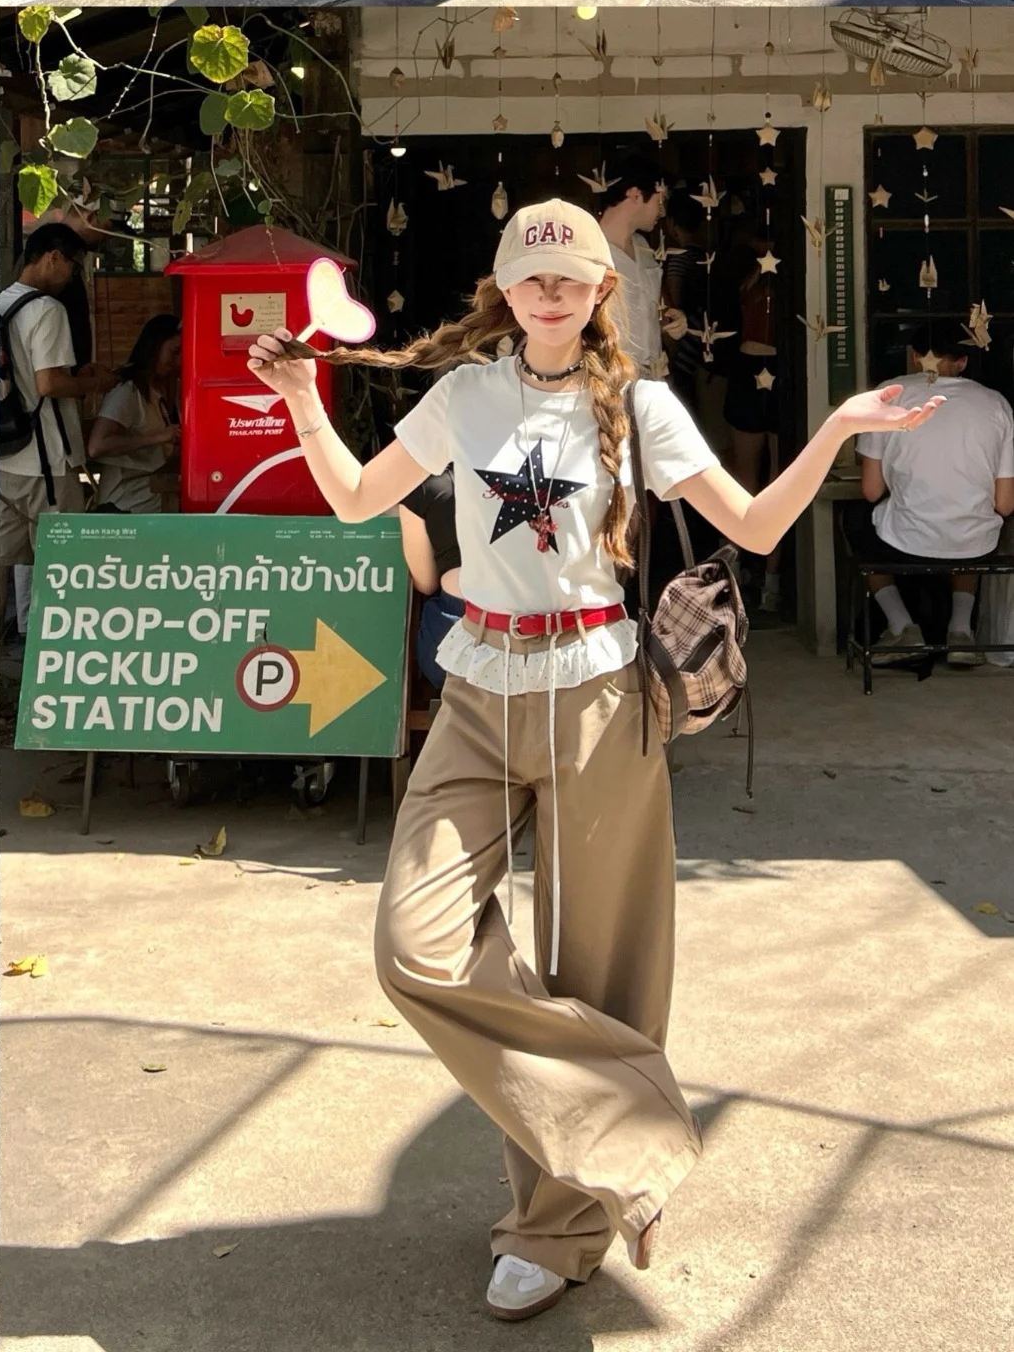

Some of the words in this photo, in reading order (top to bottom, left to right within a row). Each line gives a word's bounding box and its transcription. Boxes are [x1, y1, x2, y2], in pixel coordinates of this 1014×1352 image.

[524, 221, 575, 248] GAP
[229, 429, 263, 437] THAILAND
[264, 428, 284, 436] POST
[46, 554, 394, 602] จุดรับส่งลูกค้าข้างใน
[41, 606, 271, 643] DROP-OFF
[36, 650, 199, 686] PICKUP
[255, 660, 285, 696] P
[31, 695, 224, 733] STATION
